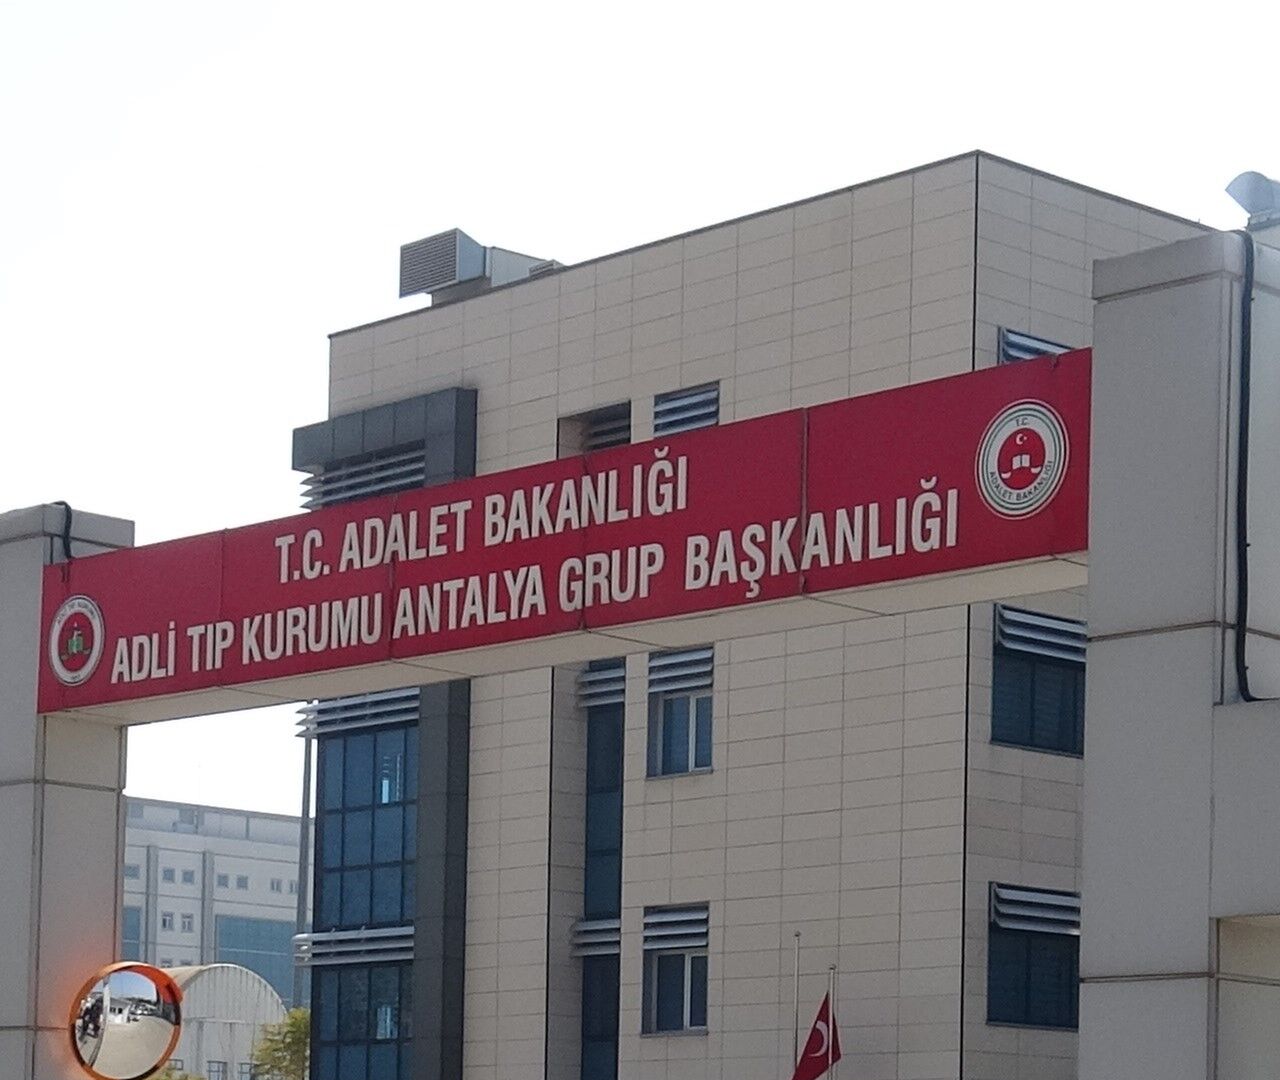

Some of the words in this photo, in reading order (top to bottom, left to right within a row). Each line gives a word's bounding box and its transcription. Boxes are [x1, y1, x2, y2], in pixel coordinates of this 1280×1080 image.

[111, 621, 177, 685] ADLİ
[187, 620, 235, 673] TIP
[242, 593, 382, 665] KURUMU
[392, 565, 547, 640] ANTALYA
[559, 543, 664, 613] GRUP
[684, 476, 959, 599] BAŞKANLIĞI
[275, 529, 330, 583] T.C.
[339, 501, 472, 573] ADALET
[484, 446, 688, 548] BAKANLIĞI
